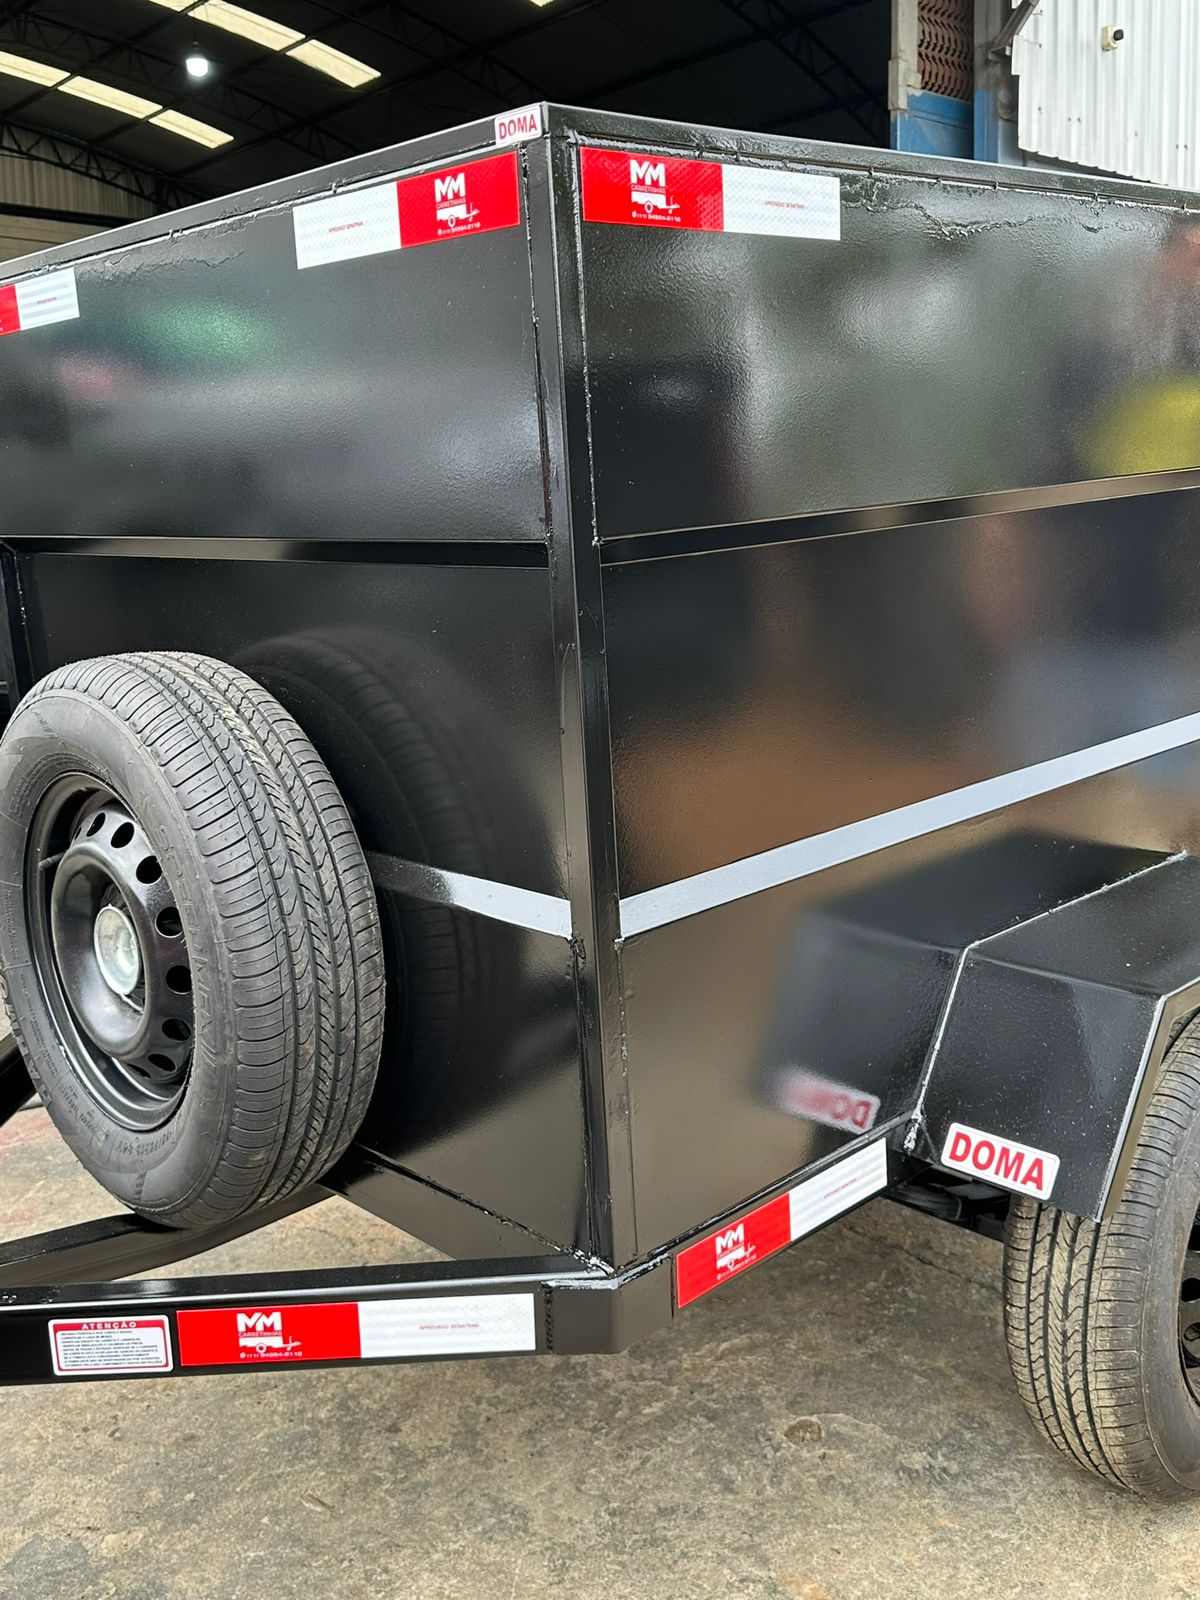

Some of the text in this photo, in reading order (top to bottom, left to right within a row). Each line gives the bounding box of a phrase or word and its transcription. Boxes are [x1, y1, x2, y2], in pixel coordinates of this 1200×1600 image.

[498, 113, 538, 140] DOMA
[630, 159, 666, 187] MM
[434, 172, 466, 203] MM
[948, 1131, 1045, 1192] DOMA
[715, 1223, 745, 1255] MM
[81, 1321, 137, 1330] ATENÇÃO
[236, 1311, 282, 1332] MM
